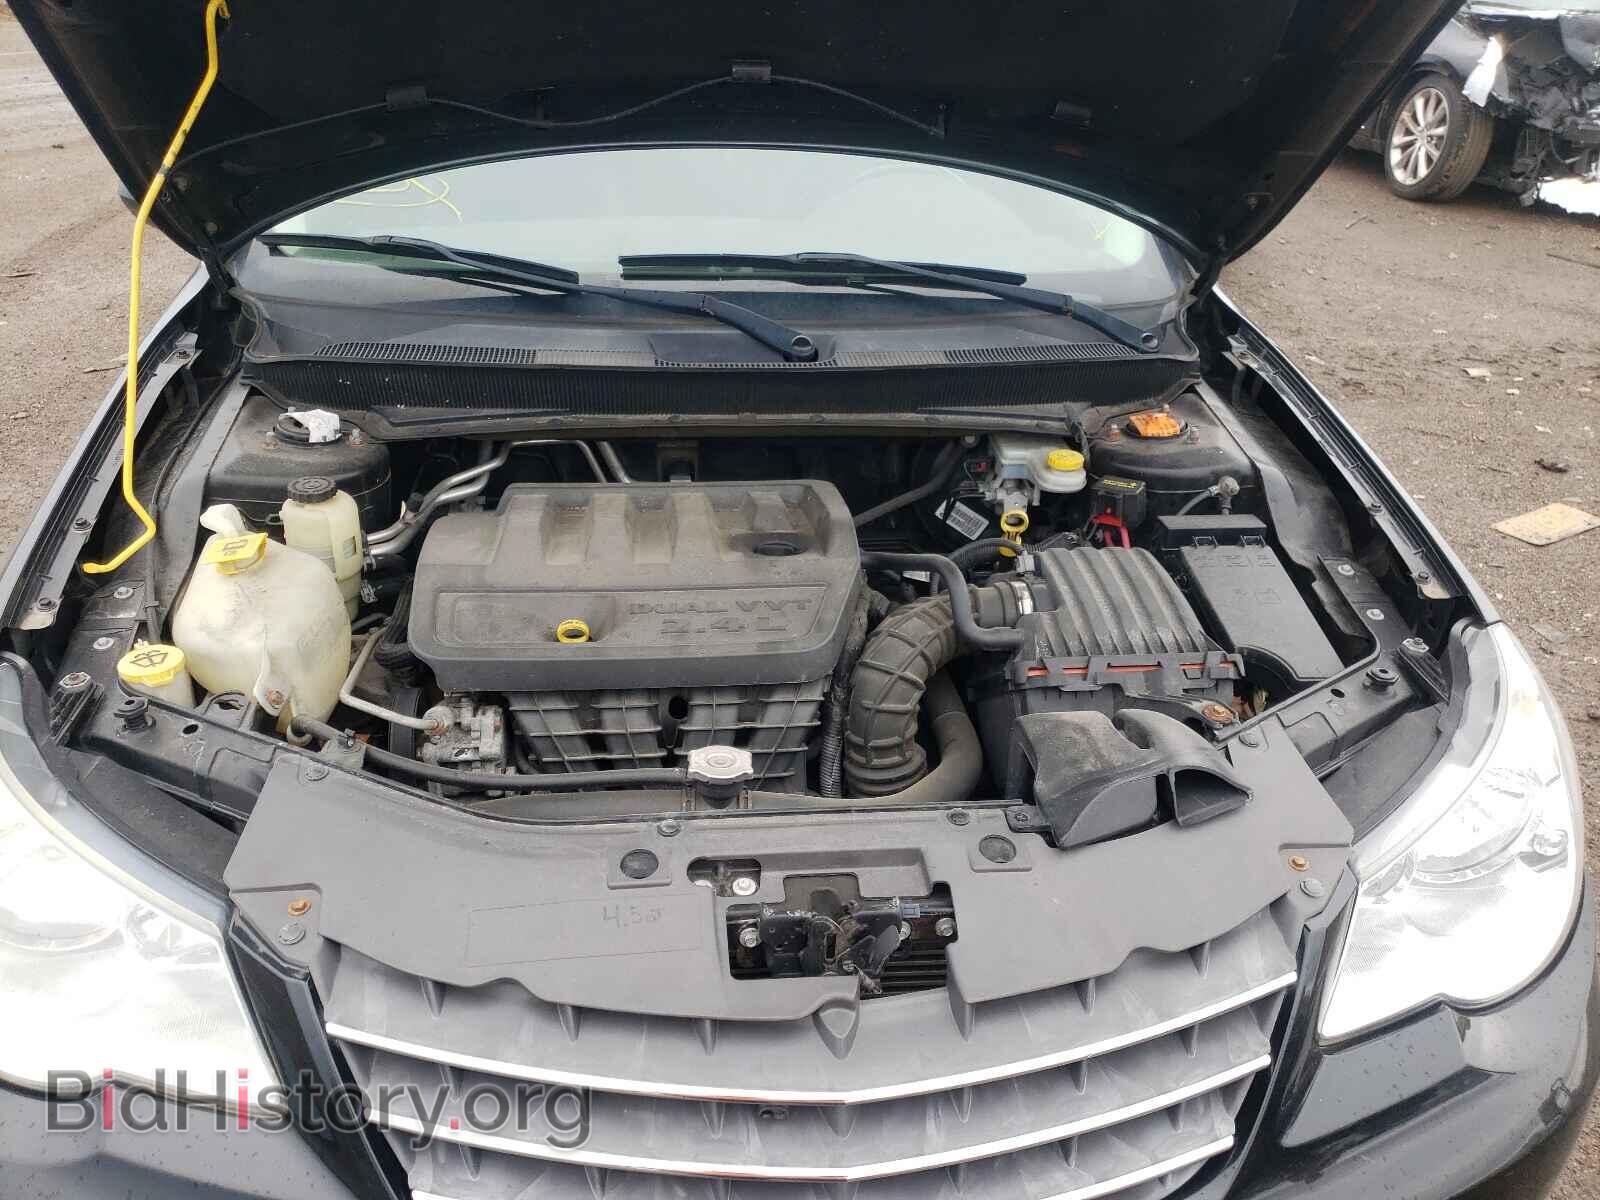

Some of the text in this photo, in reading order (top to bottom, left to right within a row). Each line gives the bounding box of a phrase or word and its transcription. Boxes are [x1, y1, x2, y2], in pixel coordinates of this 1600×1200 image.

[629, 599, 813, 615] DUAL VVT
[661, 617, 787, 634] 2.4L
